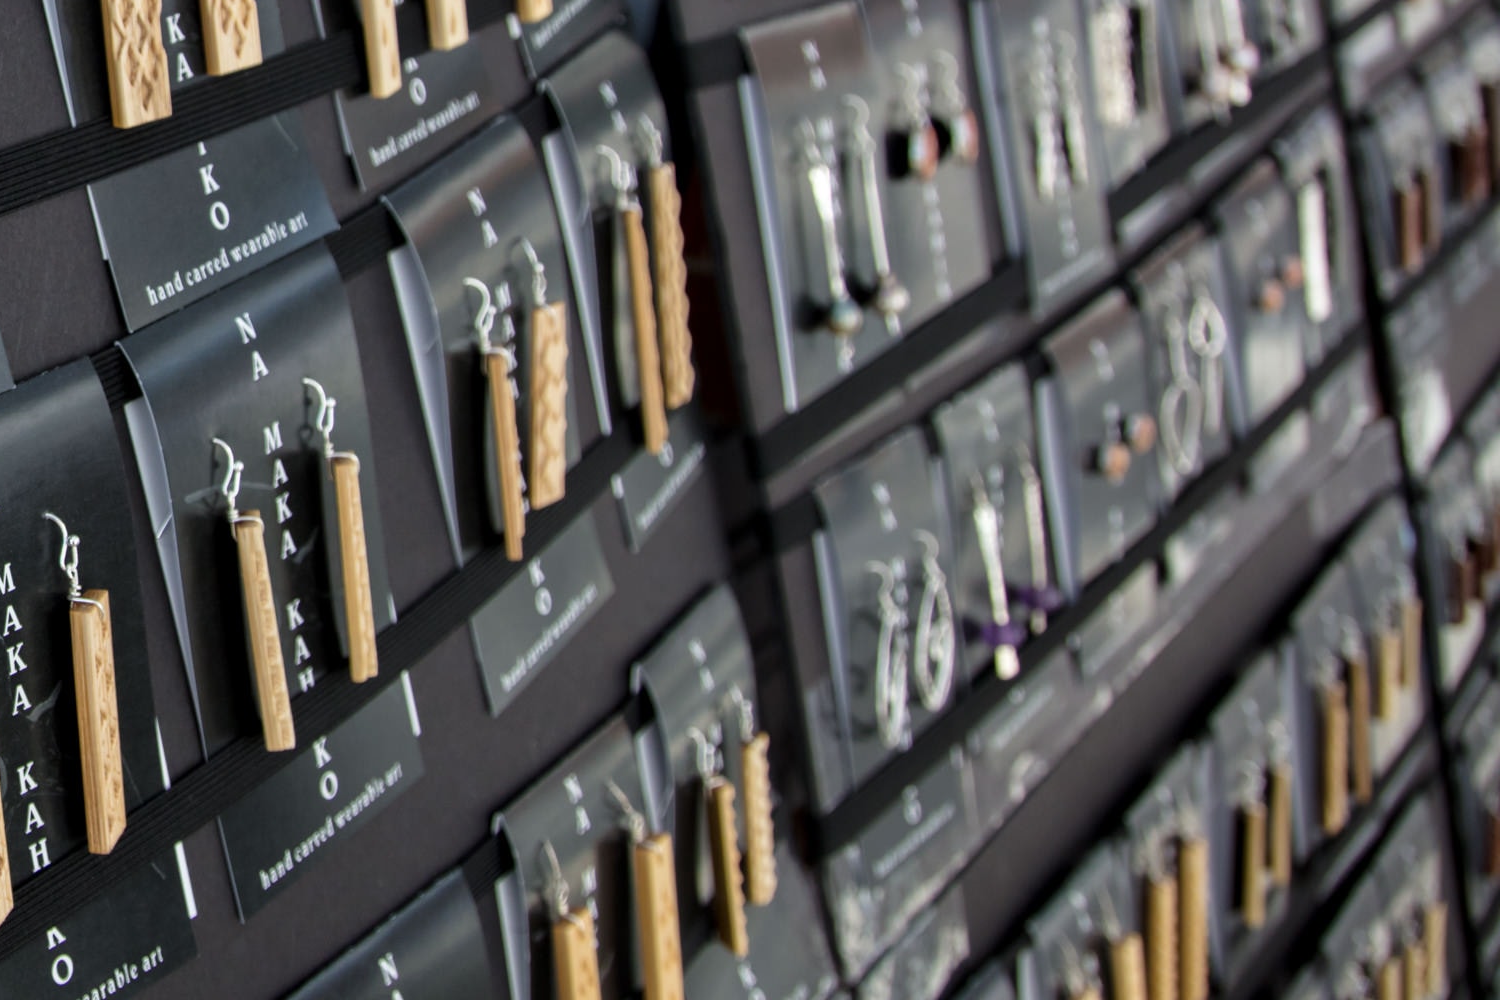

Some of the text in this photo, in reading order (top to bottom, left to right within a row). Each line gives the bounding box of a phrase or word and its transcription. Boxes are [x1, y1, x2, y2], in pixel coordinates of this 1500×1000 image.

[145, 210, 309, 307] hand carved wearable art
[234, 312, 269, 382] NA
[263, 421, 298, 560] MAKA
[258, 848, 294, 890] hand
[141, 945, 164, 972] art
